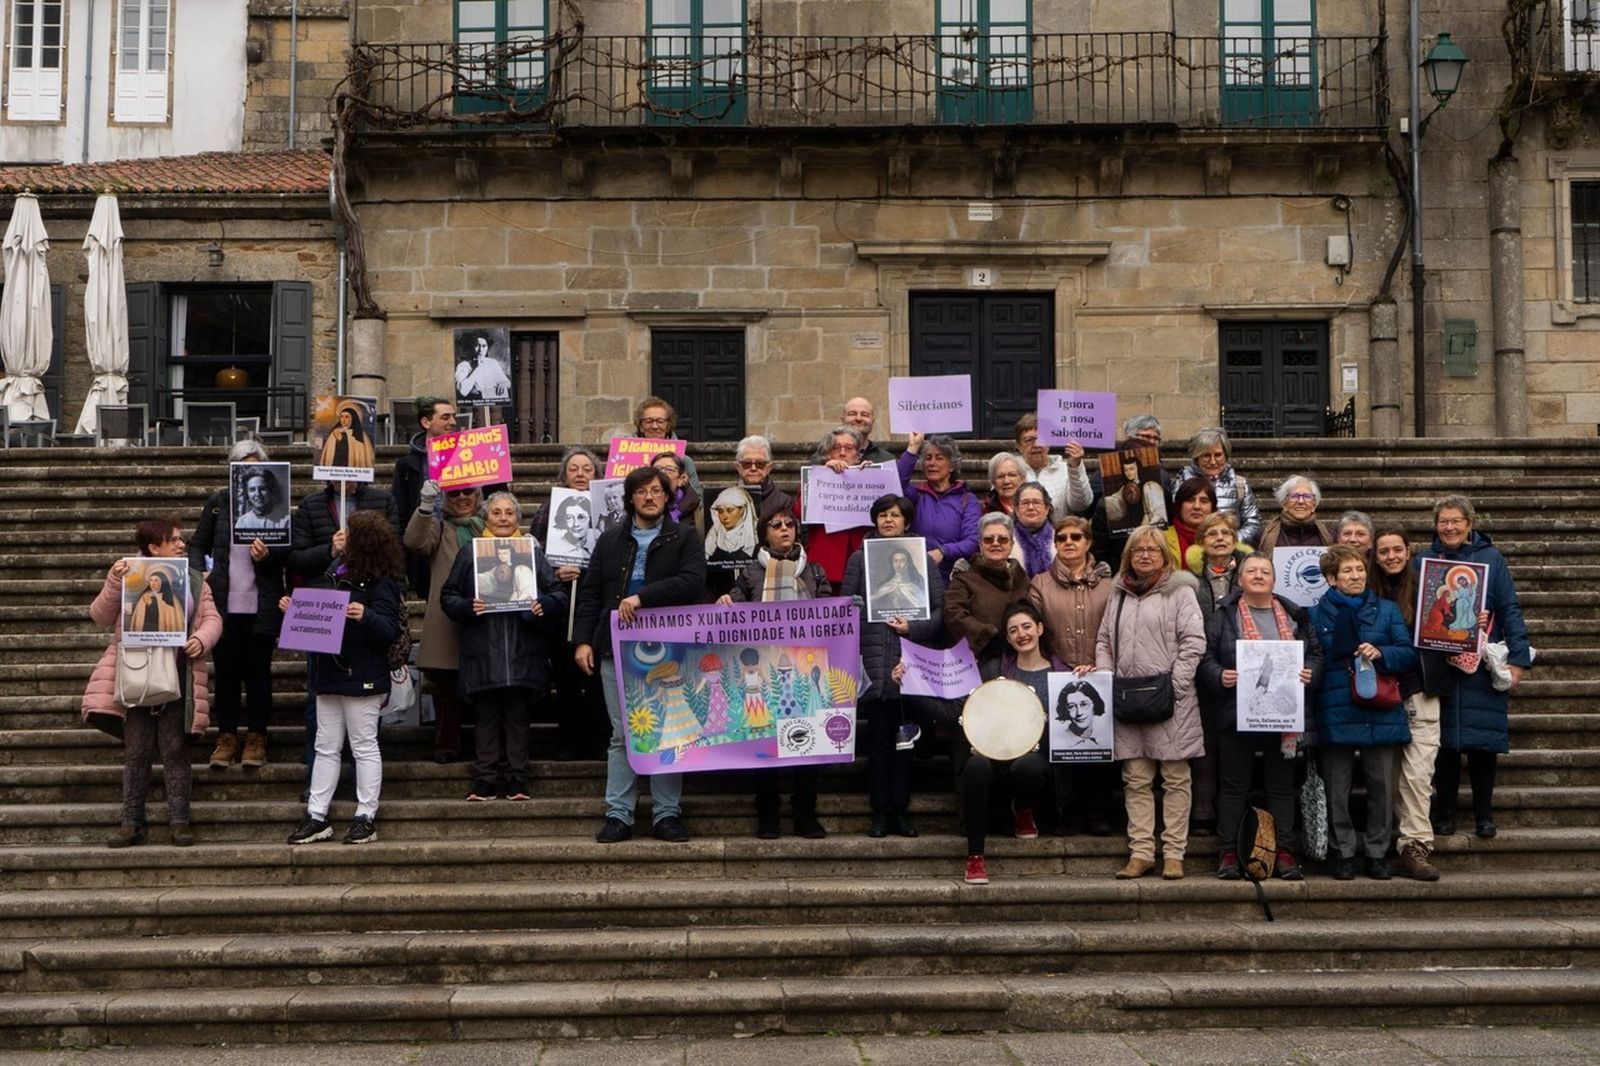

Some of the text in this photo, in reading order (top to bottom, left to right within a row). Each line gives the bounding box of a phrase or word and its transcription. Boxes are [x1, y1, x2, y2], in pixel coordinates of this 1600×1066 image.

[978, 272, 987, 283] 2
[897, 399, 964, 412] Siléncianos
[1058, 399, 1095, 412] Ignora
[1071, 415, 1095, 424] nosa
[1050, 428, 1104, 440] sabedoría
[432, 428, 502, 453] NÓS SOMOS
[618, 440, 677, 454] DIGNIDADE
[459, 448, 473, 462] O
[643, 453, 650, 464] E
[441, 458, 500, 481] CAMBIO
[816, 479, 855, 492] Prexulga
[865, 483, 886, 491] noso
[818, 492, 844, 502] corpo
[823, 503, 872, 514] sexualidad
[321, 601, 345, 611] poder
[294, 611, 333, 622] administrar
[698, 610, 746, 626] XUNTAS
[751, 608, 782, 623] POLA
[786, 604, 854, 621] IGUALDADE
[290, 625, 332, 635] sacramentos
[694, 622, 855, 644] E A DIGNIDADE NA IGREXA
